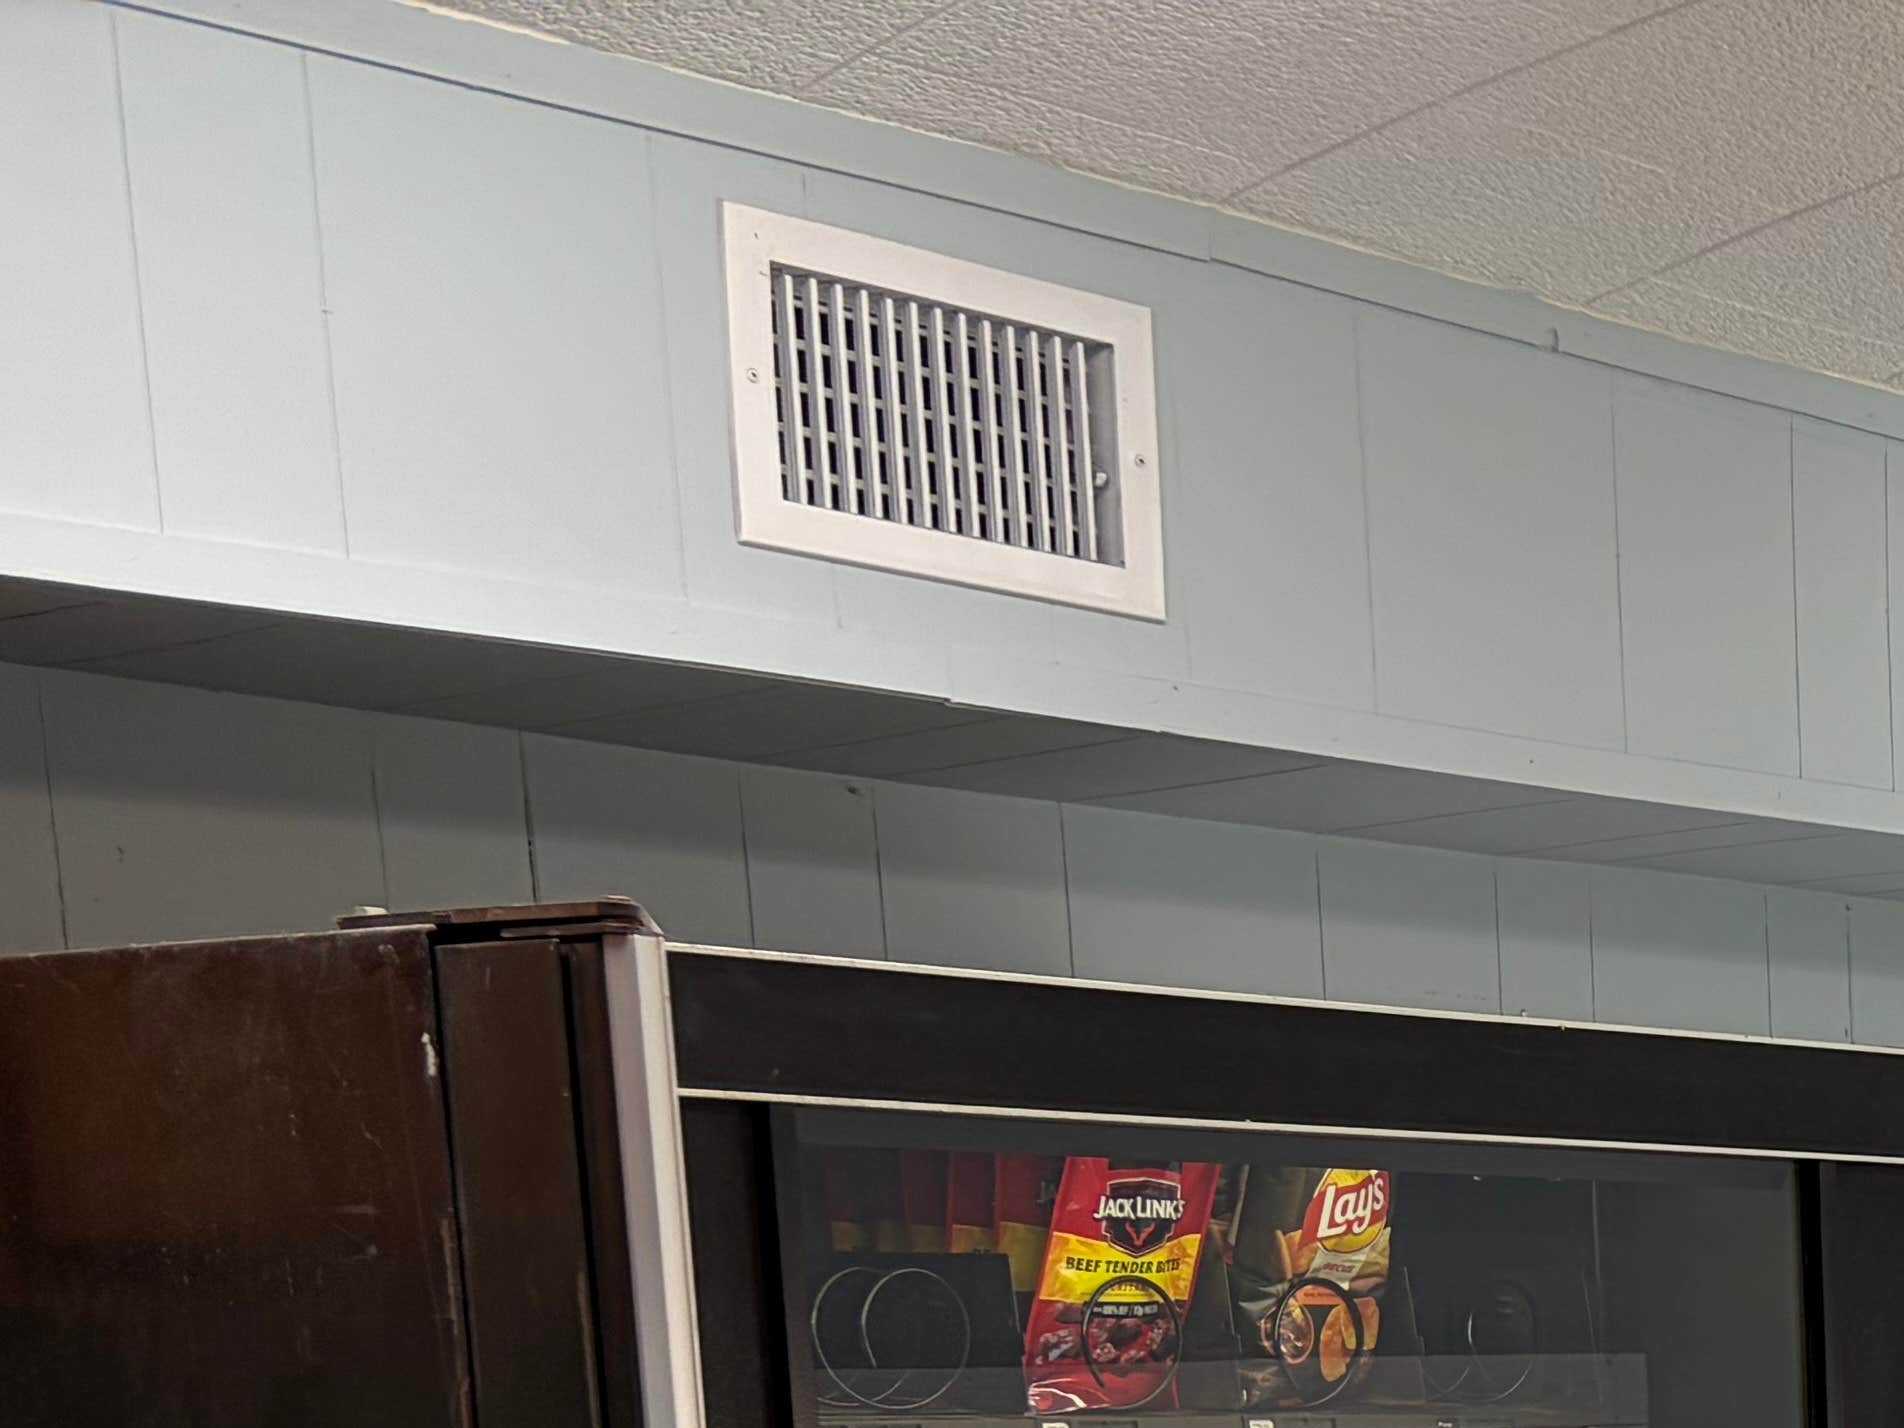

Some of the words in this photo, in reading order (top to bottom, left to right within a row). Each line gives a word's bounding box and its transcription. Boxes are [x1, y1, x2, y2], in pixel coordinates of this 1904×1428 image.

[1093, 1195, 1136, 1220] JACK
[1065, 1256, 1103, 1274] BEEF
[1104, 1259, 1154, 1275] TENDER
[1155, 1257, 1182, 1275] BITES
